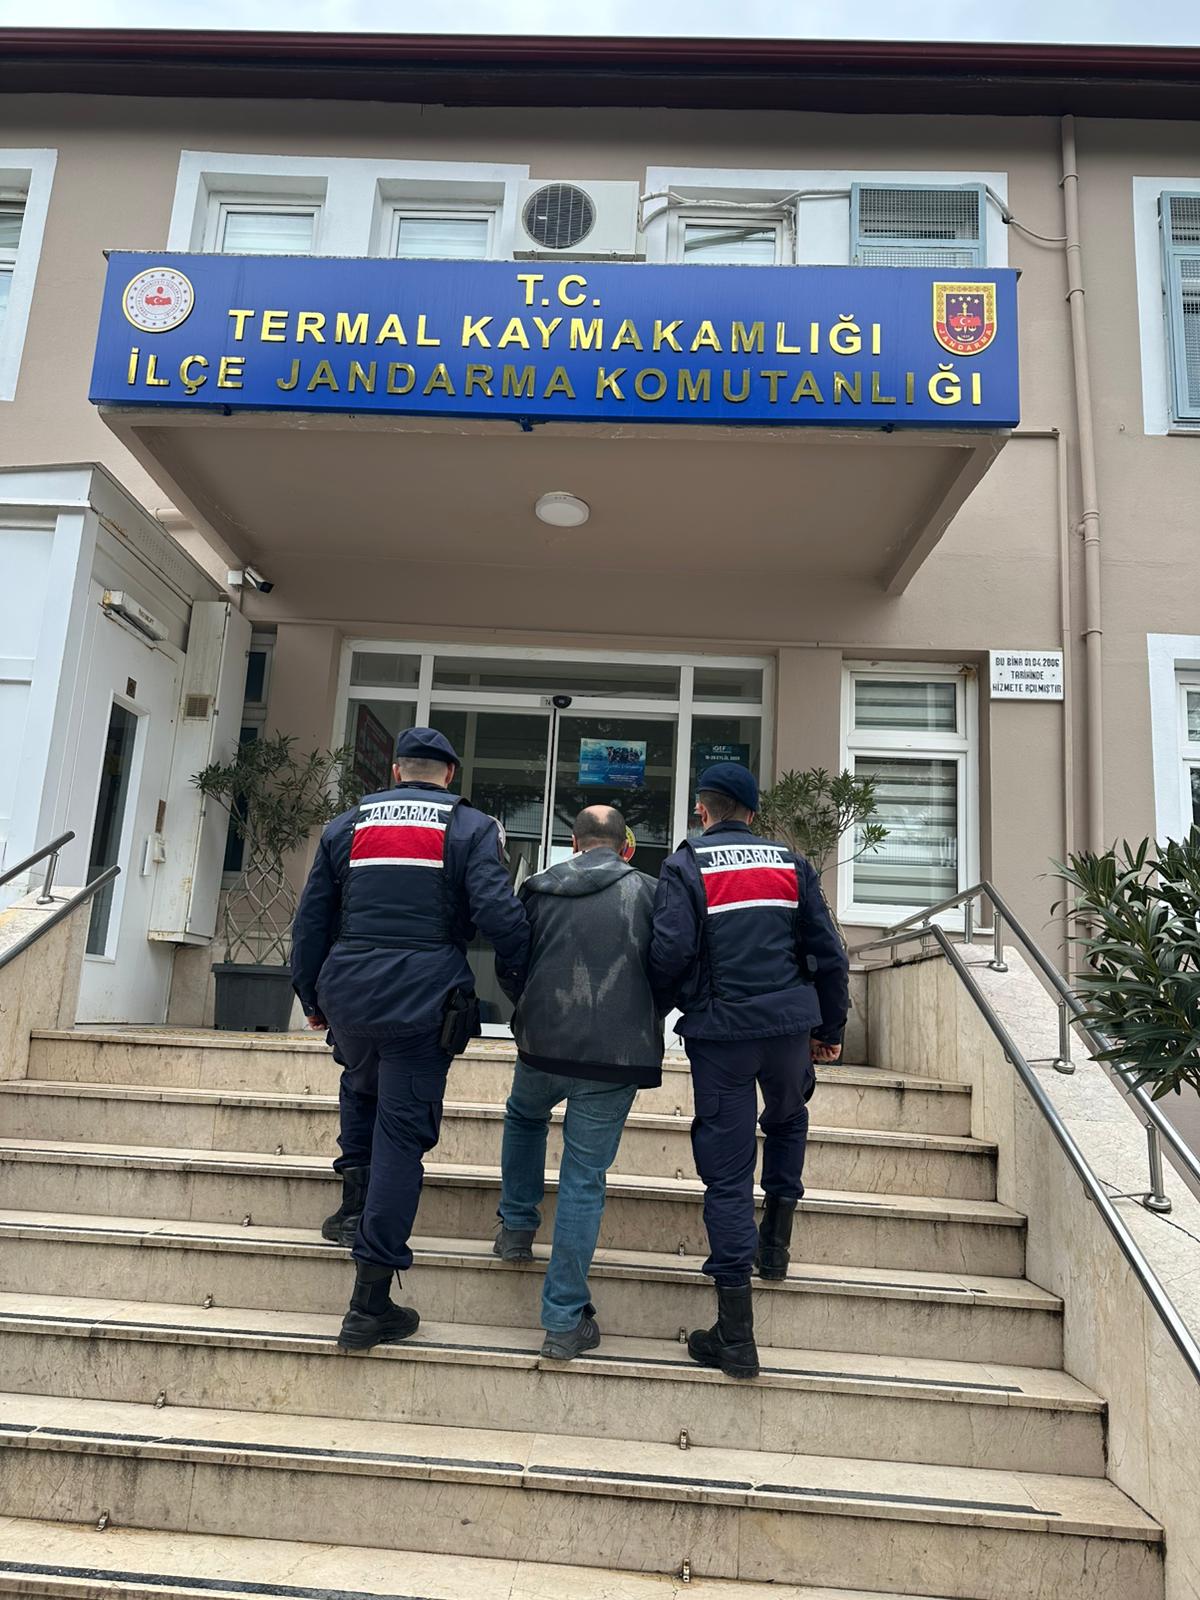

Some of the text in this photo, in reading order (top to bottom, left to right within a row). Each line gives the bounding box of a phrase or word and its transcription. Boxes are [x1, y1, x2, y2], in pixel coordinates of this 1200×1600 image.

[517, 274, 600, 307] T.C.
[228, 309, 881, 355] TERMAL KAYMAKAMLIĞI
[938, 329, 992, 351] JANDARMA
[127, 346, 982, 405] İLÇE JANDARMA KOMUTANLIĞI
[995, 657, 1005, 666] BU
[365, 805, 439, 823] JANDARMA
[708, 849, 784, 867] JANDARMA
